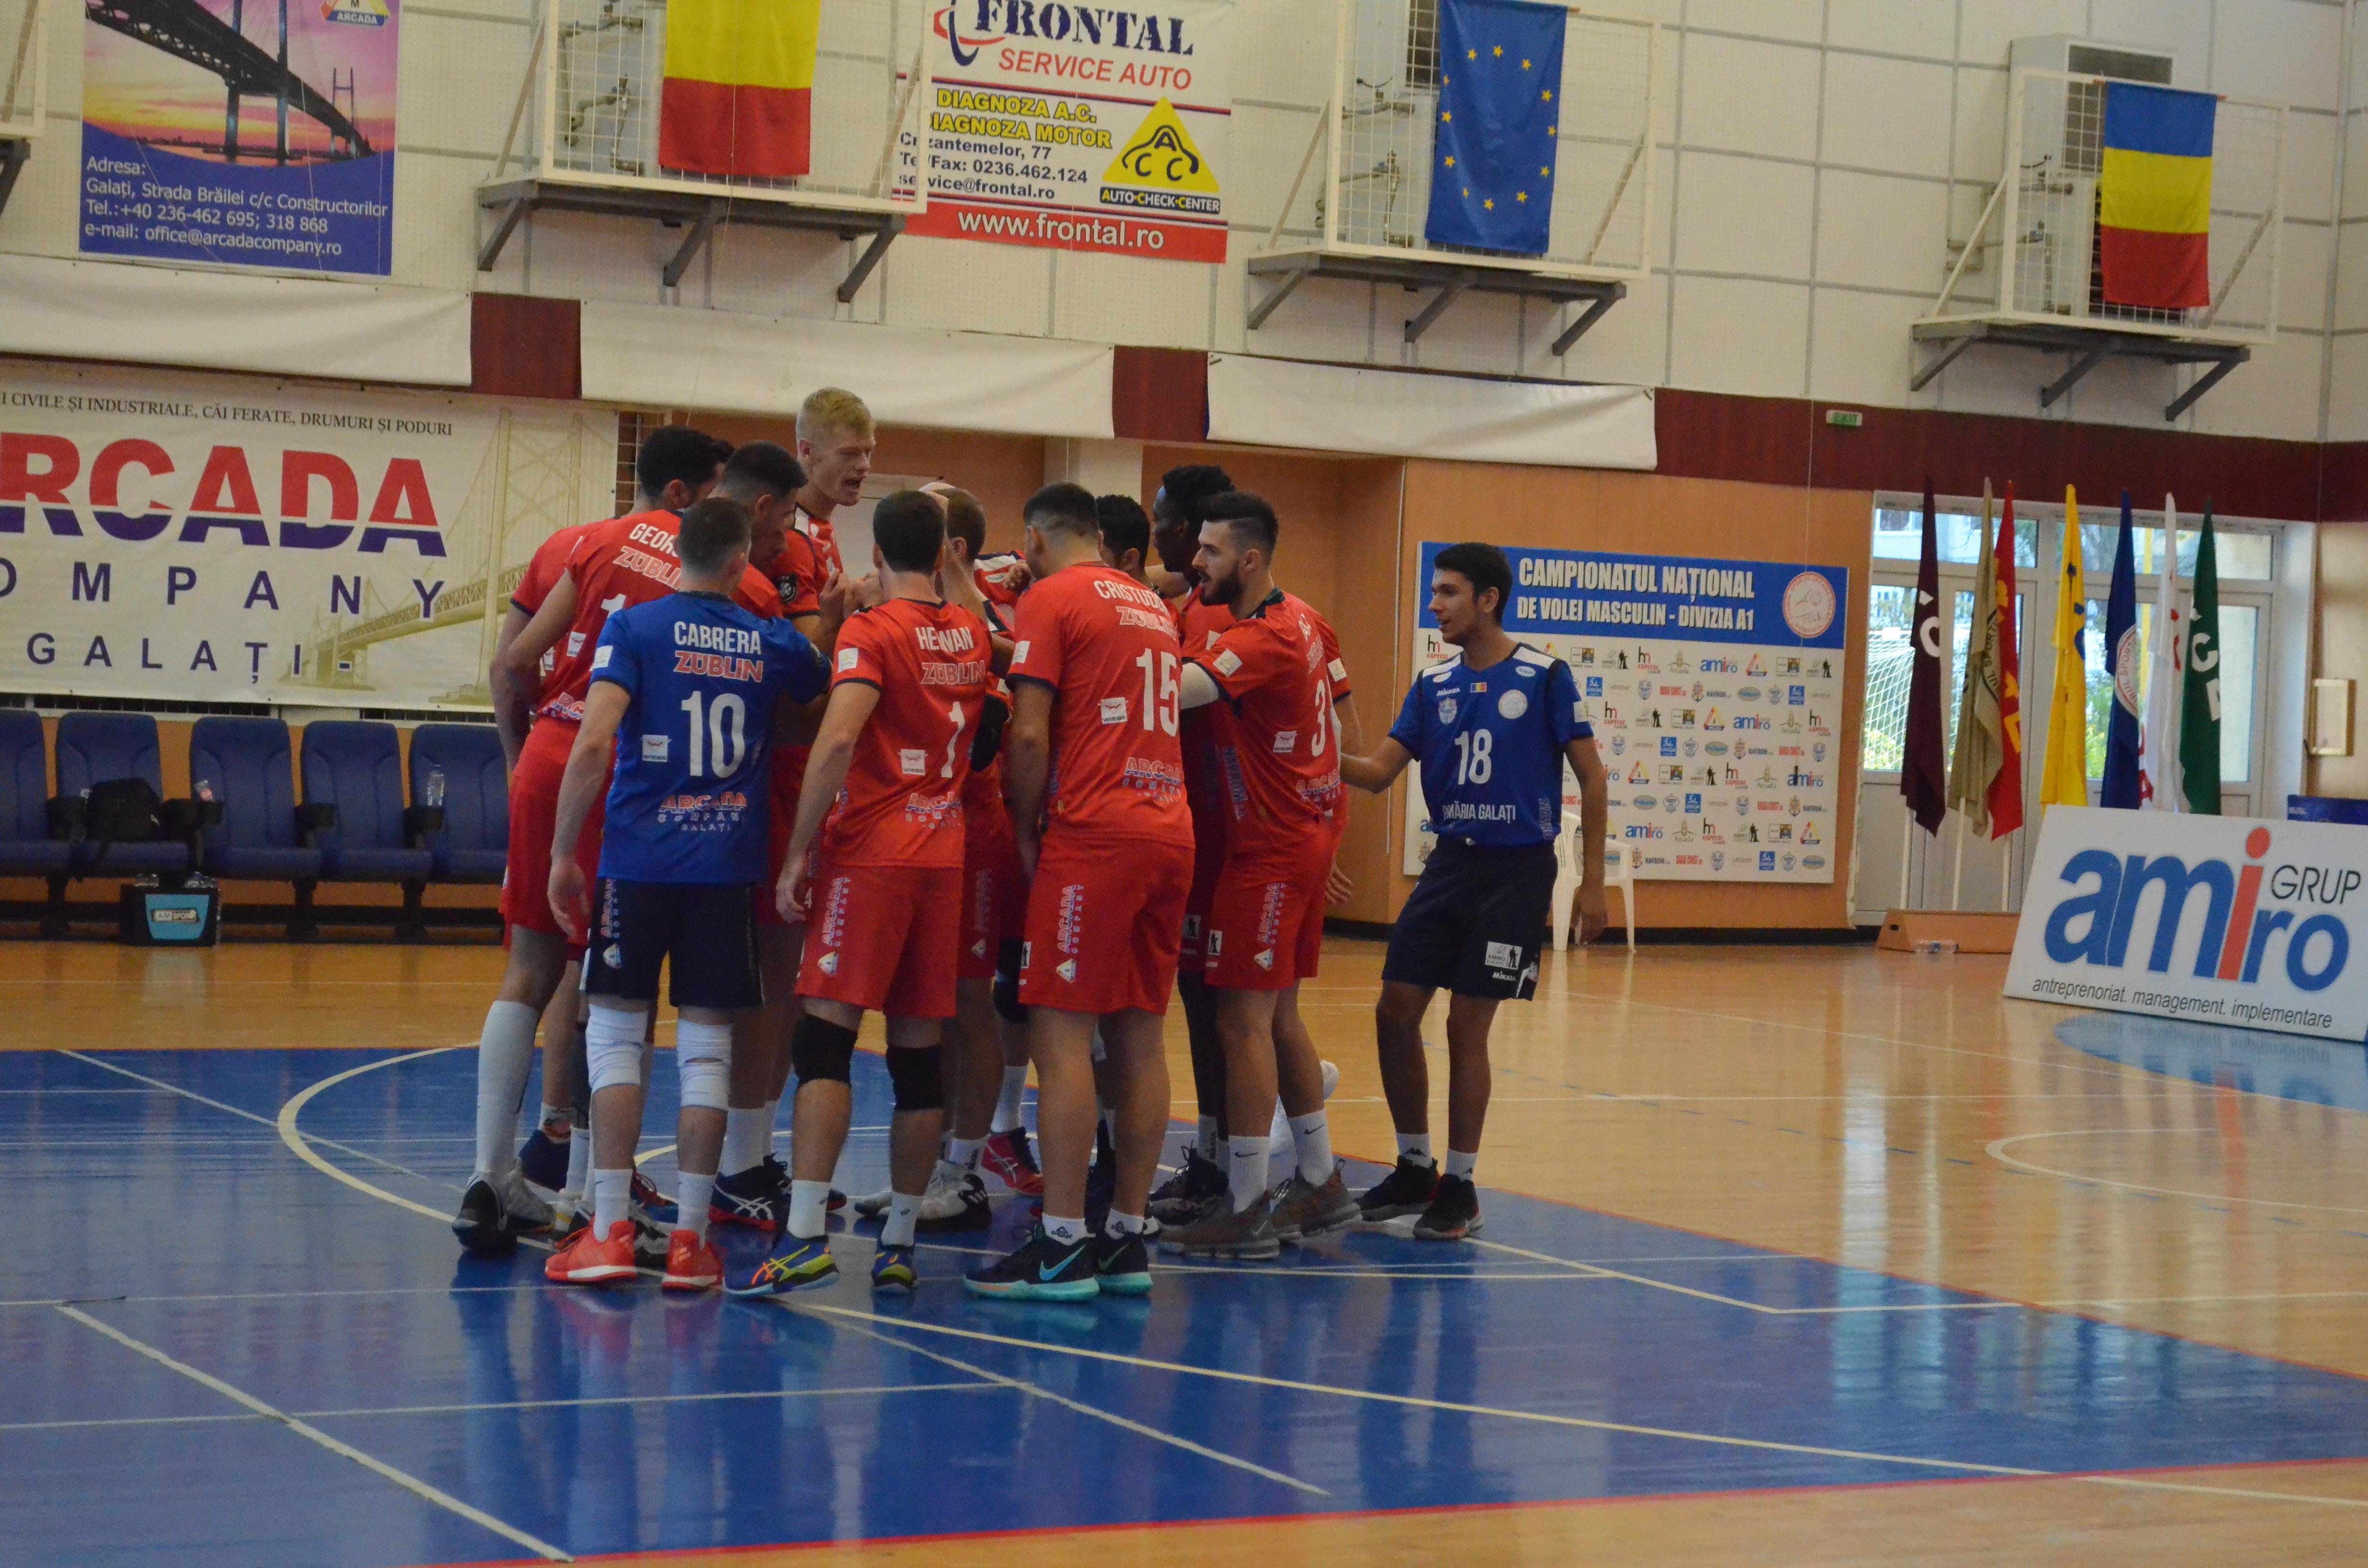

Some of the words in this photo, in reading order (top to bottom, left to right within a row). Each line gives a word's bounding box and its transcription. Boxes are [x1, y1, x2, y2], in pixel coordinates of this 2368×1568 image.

[337, 11, 377, 24] ARCADA
[974, 0, 1194, 56] FRONTAL
[998, 48, 1114, 82] SERVICE
[1120, 62, 1192, 90] AUTO
[937, 88, 1050, 119] DIAGNOZA
[1054, 101, 1098, 123] A.C.
[930, 112, 1031, 141] IAGNOZA
[1036, 123, 1113, 149] MOTOR
[86, 156, 146, 175] Adresa:
[1032, 146, 1051, 160] 77
[899, 174, 1055, 199] sevice@frontal.ro
[973, 159, 1088, 184] 0236.462.124
[142, 182, 192, 201] Strada
[249, 192, 272, 209] c/c
[277, 193, 388, 217] Constructorilor
[157, 204, 221, 225] 236-462
[226, 210, 259, 231] 695;
[266, 214, 294, 230] 318
[300, 216, 328, 233] 868
[958, 211, 1164, 249] www.frontal.ro
[85, 223, 139, 239] e-mail:
[145, 225, 342, 257] office@arcadacompany.ro
[11, 392, 64, 409] CIVILE
[87, 397, 198, 419] INDUSTRIALE,
[232, 407, 296, 425] FERATE,
[300, 412, 373, 430] DRUMURI
[395, 419, 452, 436] PODURI
[1519, 558, 1658, 593] CAMPIONATUL
[1517, 597, 1537, 620] DE
[1540, 598, 1583, 622] VOLEI
[1586, 600, 1666, 627] MASCULIN
[1678, 605, 1734, 630] DIVIZIA
[1736, 609, 1754, 631] A1
[674, 621, 762, 655] CABRERA
[673, 650, 764, 683] ZÜBLIN
[1700, 656, 1738, 674] amiro
[1135, 648, 1179, 737] 15
[681, 690, 745, 778] 10
[1311, 679, 1326, 757] 3
[1733, 713, 1771, 730] amiro
[941, 701, 965, 779] 1
[1454, 728, 1492, 785] 18
[1625, 822, 1664, 839] amiro
[2270, 865, 2362, 905] GRUP
[1057, 884, 1076, 953] ARCADA
[2044, 826, 2350, 992] amiro
[2032, 978, 2127, 1004] antreprenoriat.
[2132, 991, 2226, 1015] management.
[2231, 999, 2332, 1029] implementare
